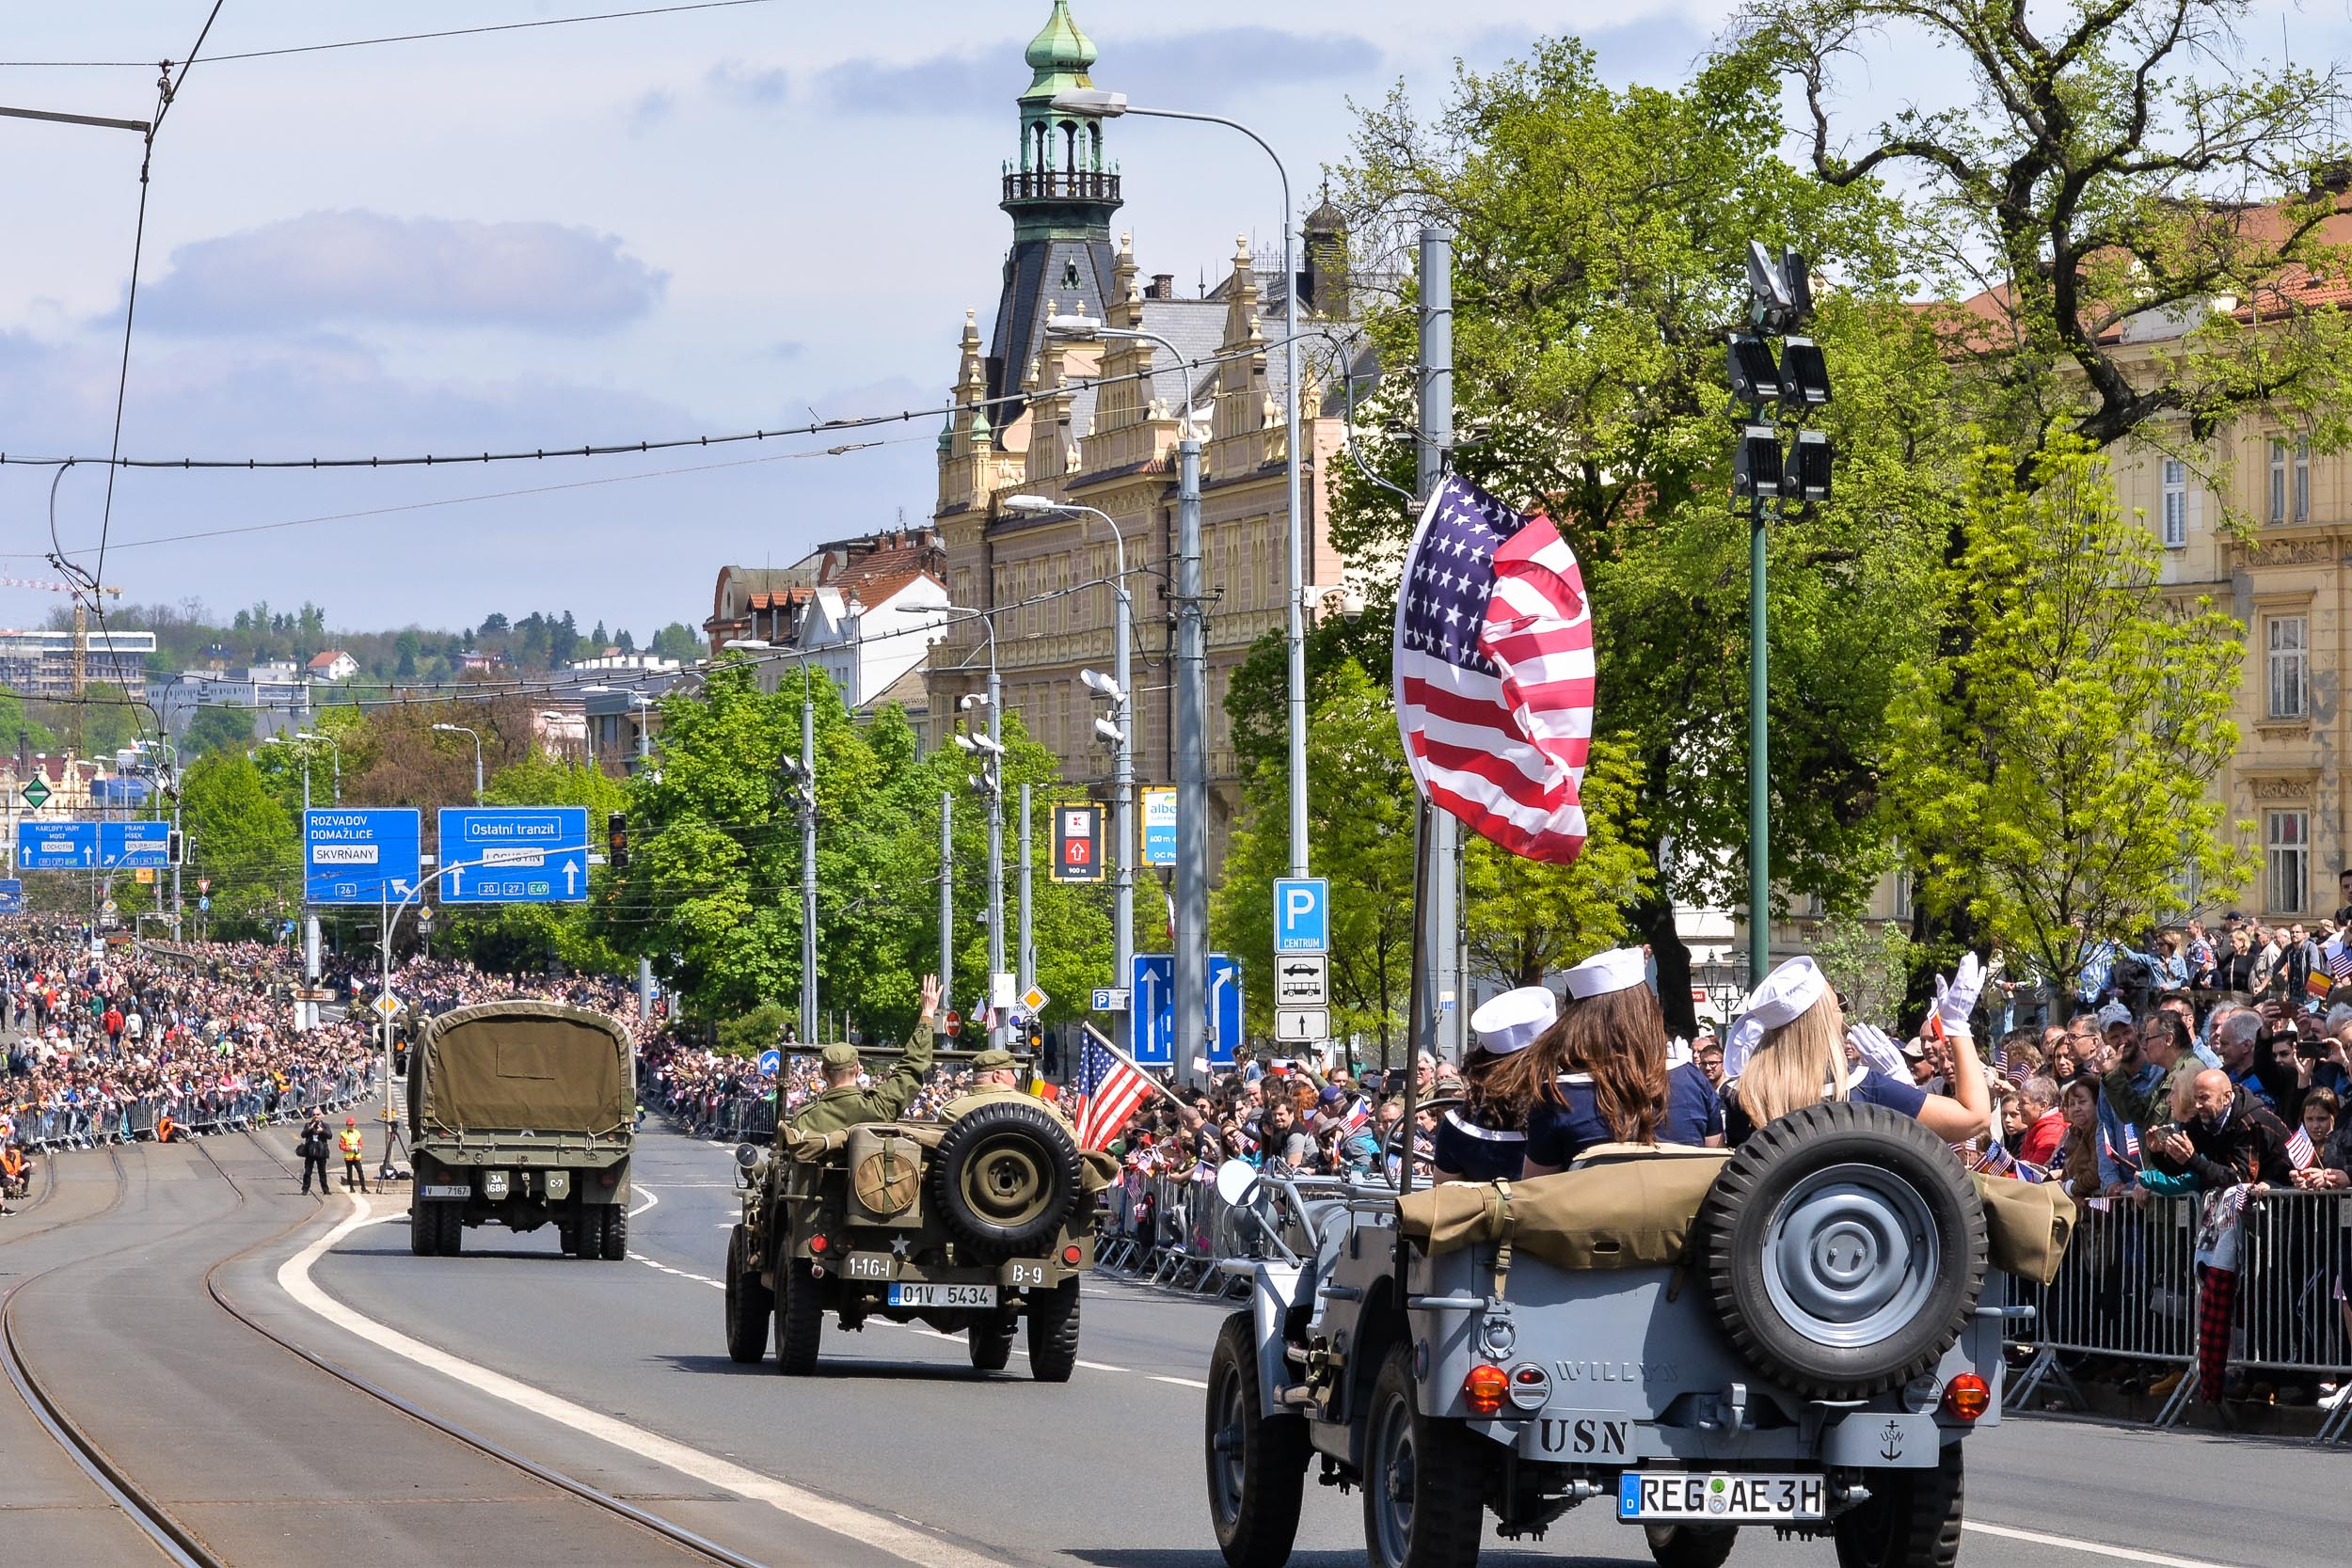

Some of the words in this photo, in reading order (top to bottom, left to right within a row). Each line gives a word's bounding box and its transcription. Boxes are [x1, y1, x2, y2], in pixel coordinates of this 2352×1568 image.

[310, 816, 368, 826] ROZVADOV
[310, 827, 373, 840] DOMAŽLICE
[472, 823, 514, 835] Ostatní
[517, 823, 555, 834] tranzit
[316, 847, 374, 860] SKVRŇANY
[341, 886, 351, 895] 26
[484, 885, 495, 894] 20
[508, 885, 519, 894] 27
[530, 884, 548, 894] E49
[1287, 889, 1315, 930] P
[1283, 938, 1320, 948] CENTRUM
[491, 1175, 502, 1183] 3A
[549, 1179, 564, 1188] C-7
[427, 1186, 433, 1196] V
[447, 1186, 467, 1196] 7167
[1012, 1264, 1042, 1284] B-9
[947, 1288, 989, 1305] 5434
[1555, 1360, 1678, 1382] WILLYS
[1539, 1418, 1628, 1455] USN
[1880, 1430, 1904, 1443] USN
[1640, 1478, 1705, 1513] REG
[1626, 1498, 1634, 1510] D
